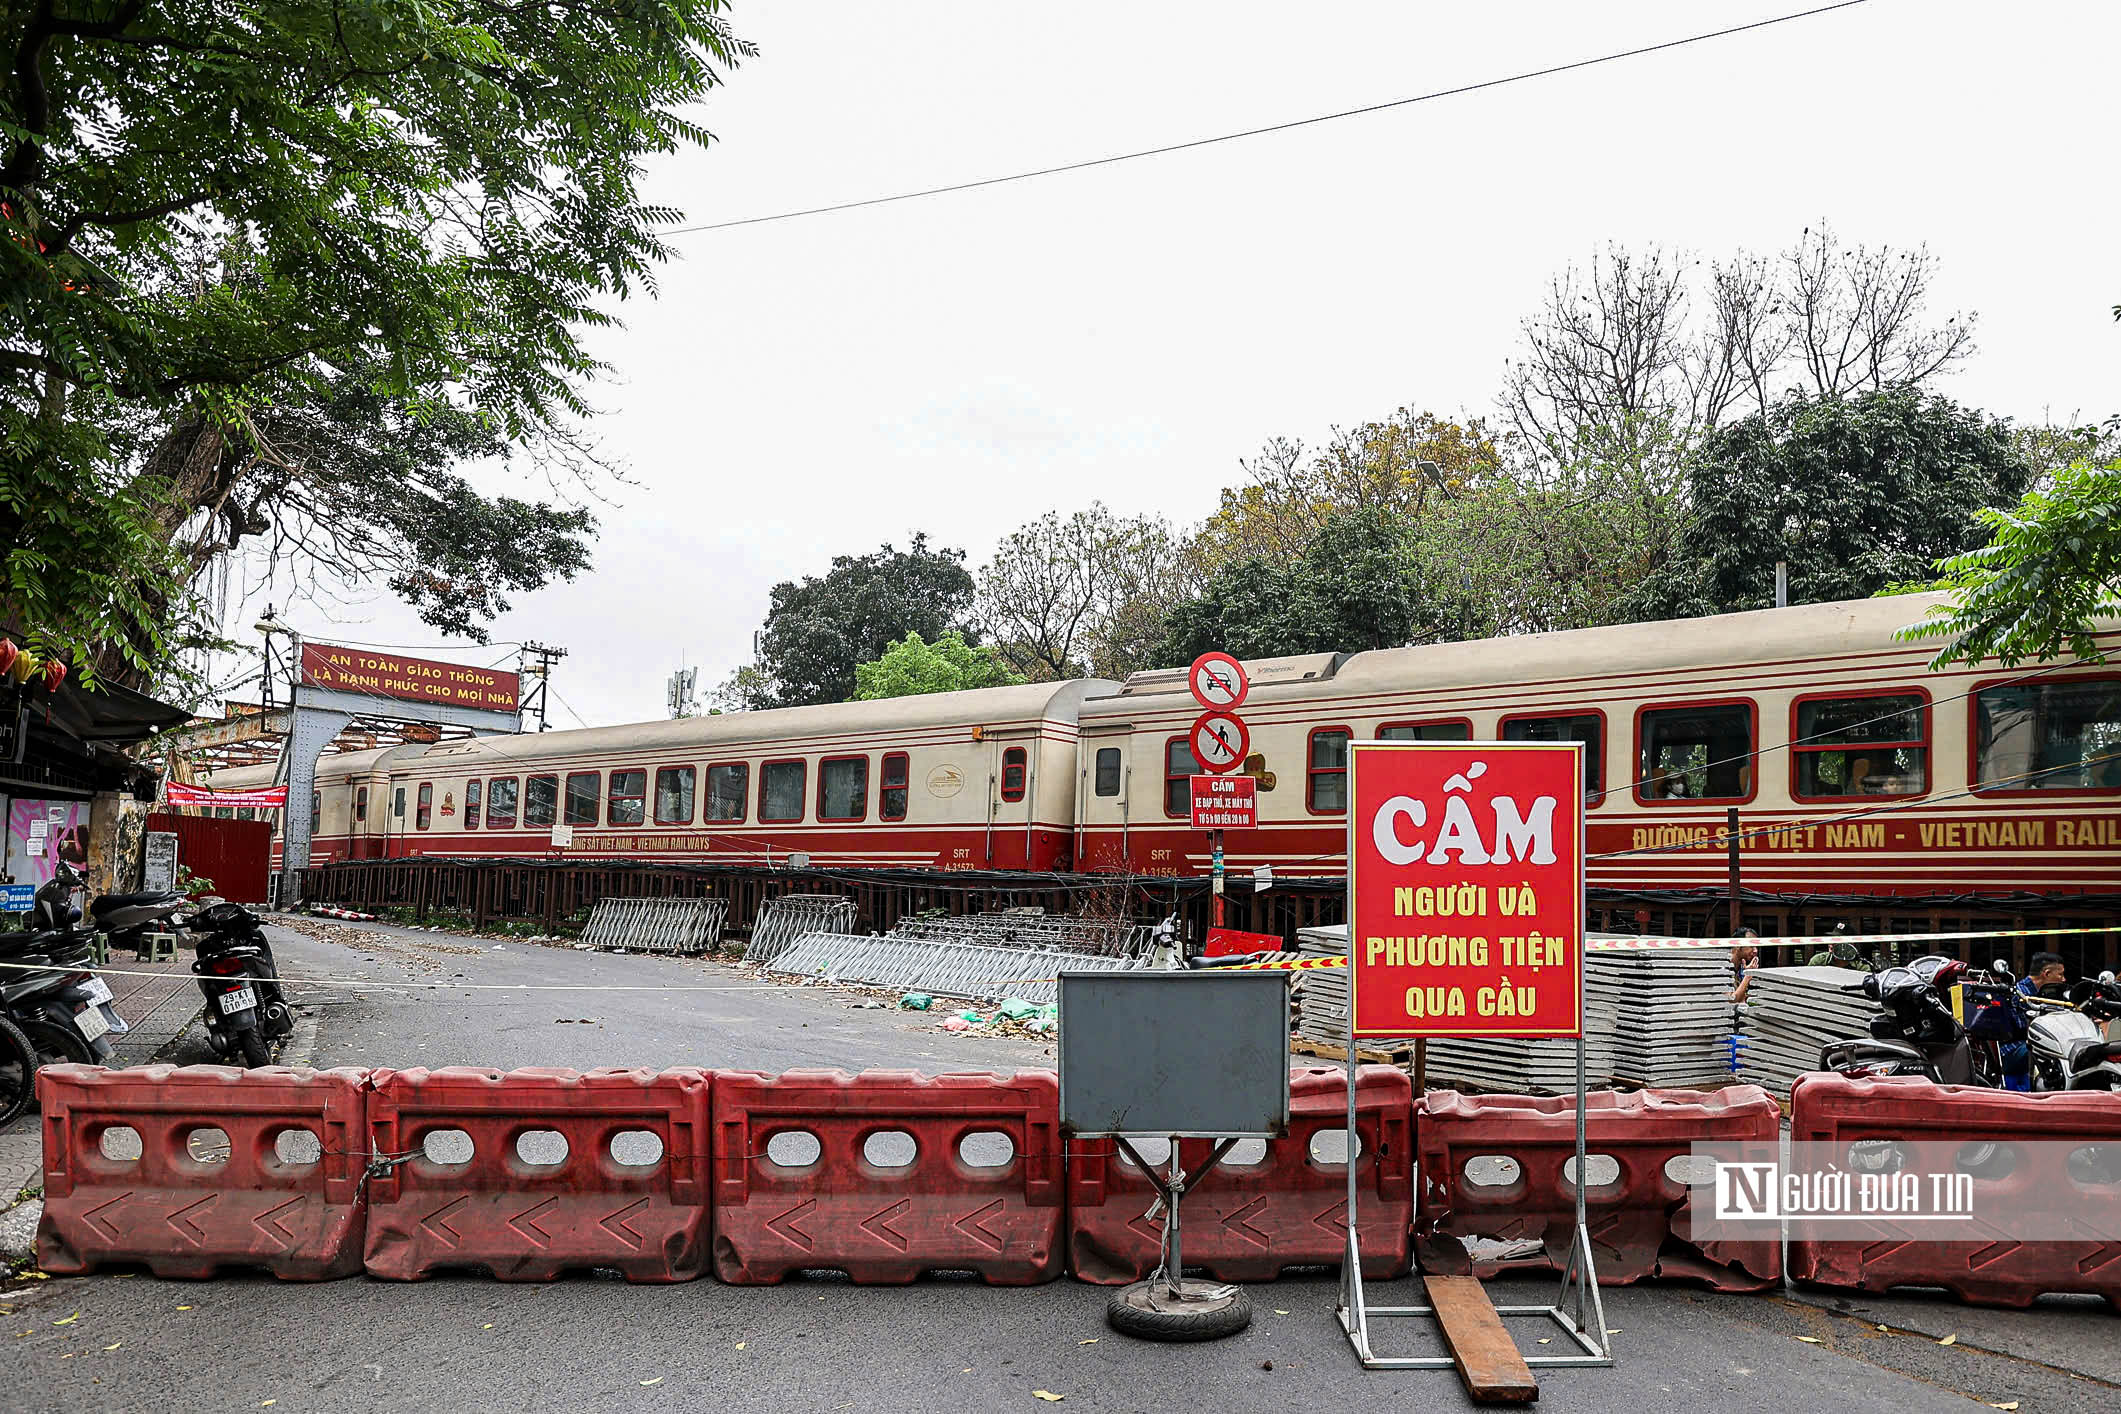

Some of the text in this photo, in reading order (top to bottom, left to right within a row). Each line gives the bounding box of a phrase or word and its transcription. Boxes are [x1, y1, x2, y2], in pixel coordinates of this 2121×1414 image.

[313, 666, 514, 706] LÀ HẠNH PHÚC CHO MỌI NHÀ
[329, 654, 495, 686] AN TOÀN GIAO THÔNG
[1211, 778, 1235, 792] CẤM
[1195, 797, 1202, 808] XE
[1225, 797, 1232, 809] XE
[1372, 761, 1558, 865] CẤM
[616, 837, 632, 850] NAM
[637, 836, 670, 850] VIETNAM
[670, 836, 710, 850] RAILWAYS
[1632, 822, 1709, 849] ĐƯỜNG
[1766, 819, 1818, 853] VIỆT
[1825, 823, 1886, 848] NAM
[1919, 820, 2045, 848] VIETNAM
[953, 848, 970, 859] SRT
[1151, 849, 1172, 860] SRT
[1394, 880, 1538, 916] NGƯỜI VÀ
[1366, 930, 1565, 972] PHƯƠNG TIỆN
[1405, 976, 1537, 1019] QUA CẦU
